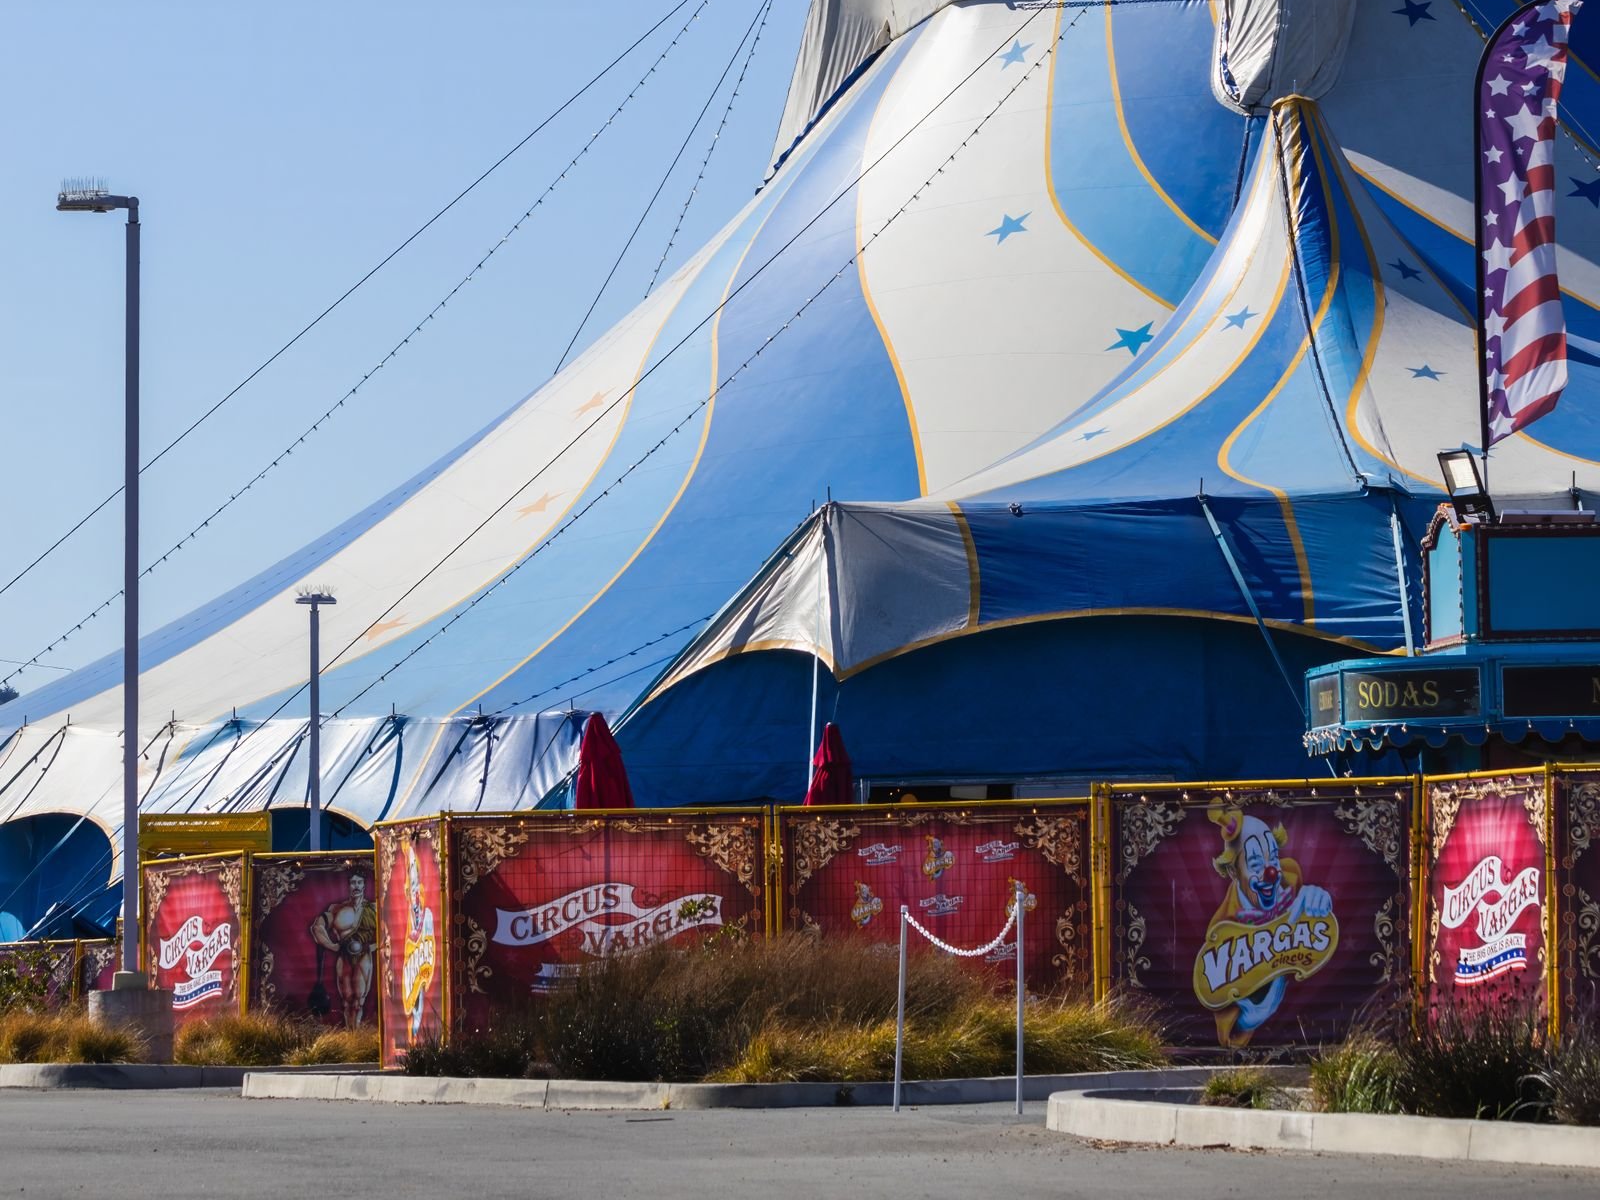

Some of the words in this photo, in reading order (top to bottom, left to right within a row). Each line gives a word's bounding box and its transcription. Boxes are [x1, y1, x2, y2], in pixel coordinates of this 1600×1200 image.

[1358, 680, 1440, 709] SODAS
[510, 885, 621, 940] CIRCUS
[1449, 860, 1495, 921] CIRCUS
[1480, 871, 1536, 937] VARGAS
[165, 918, 198, 964] CIRCUS
[188, 925, 229, 974] VARGAS
[1202, 921, 1331, 993] VARGAS
[404, 940, 433, 1000] VARGAS
